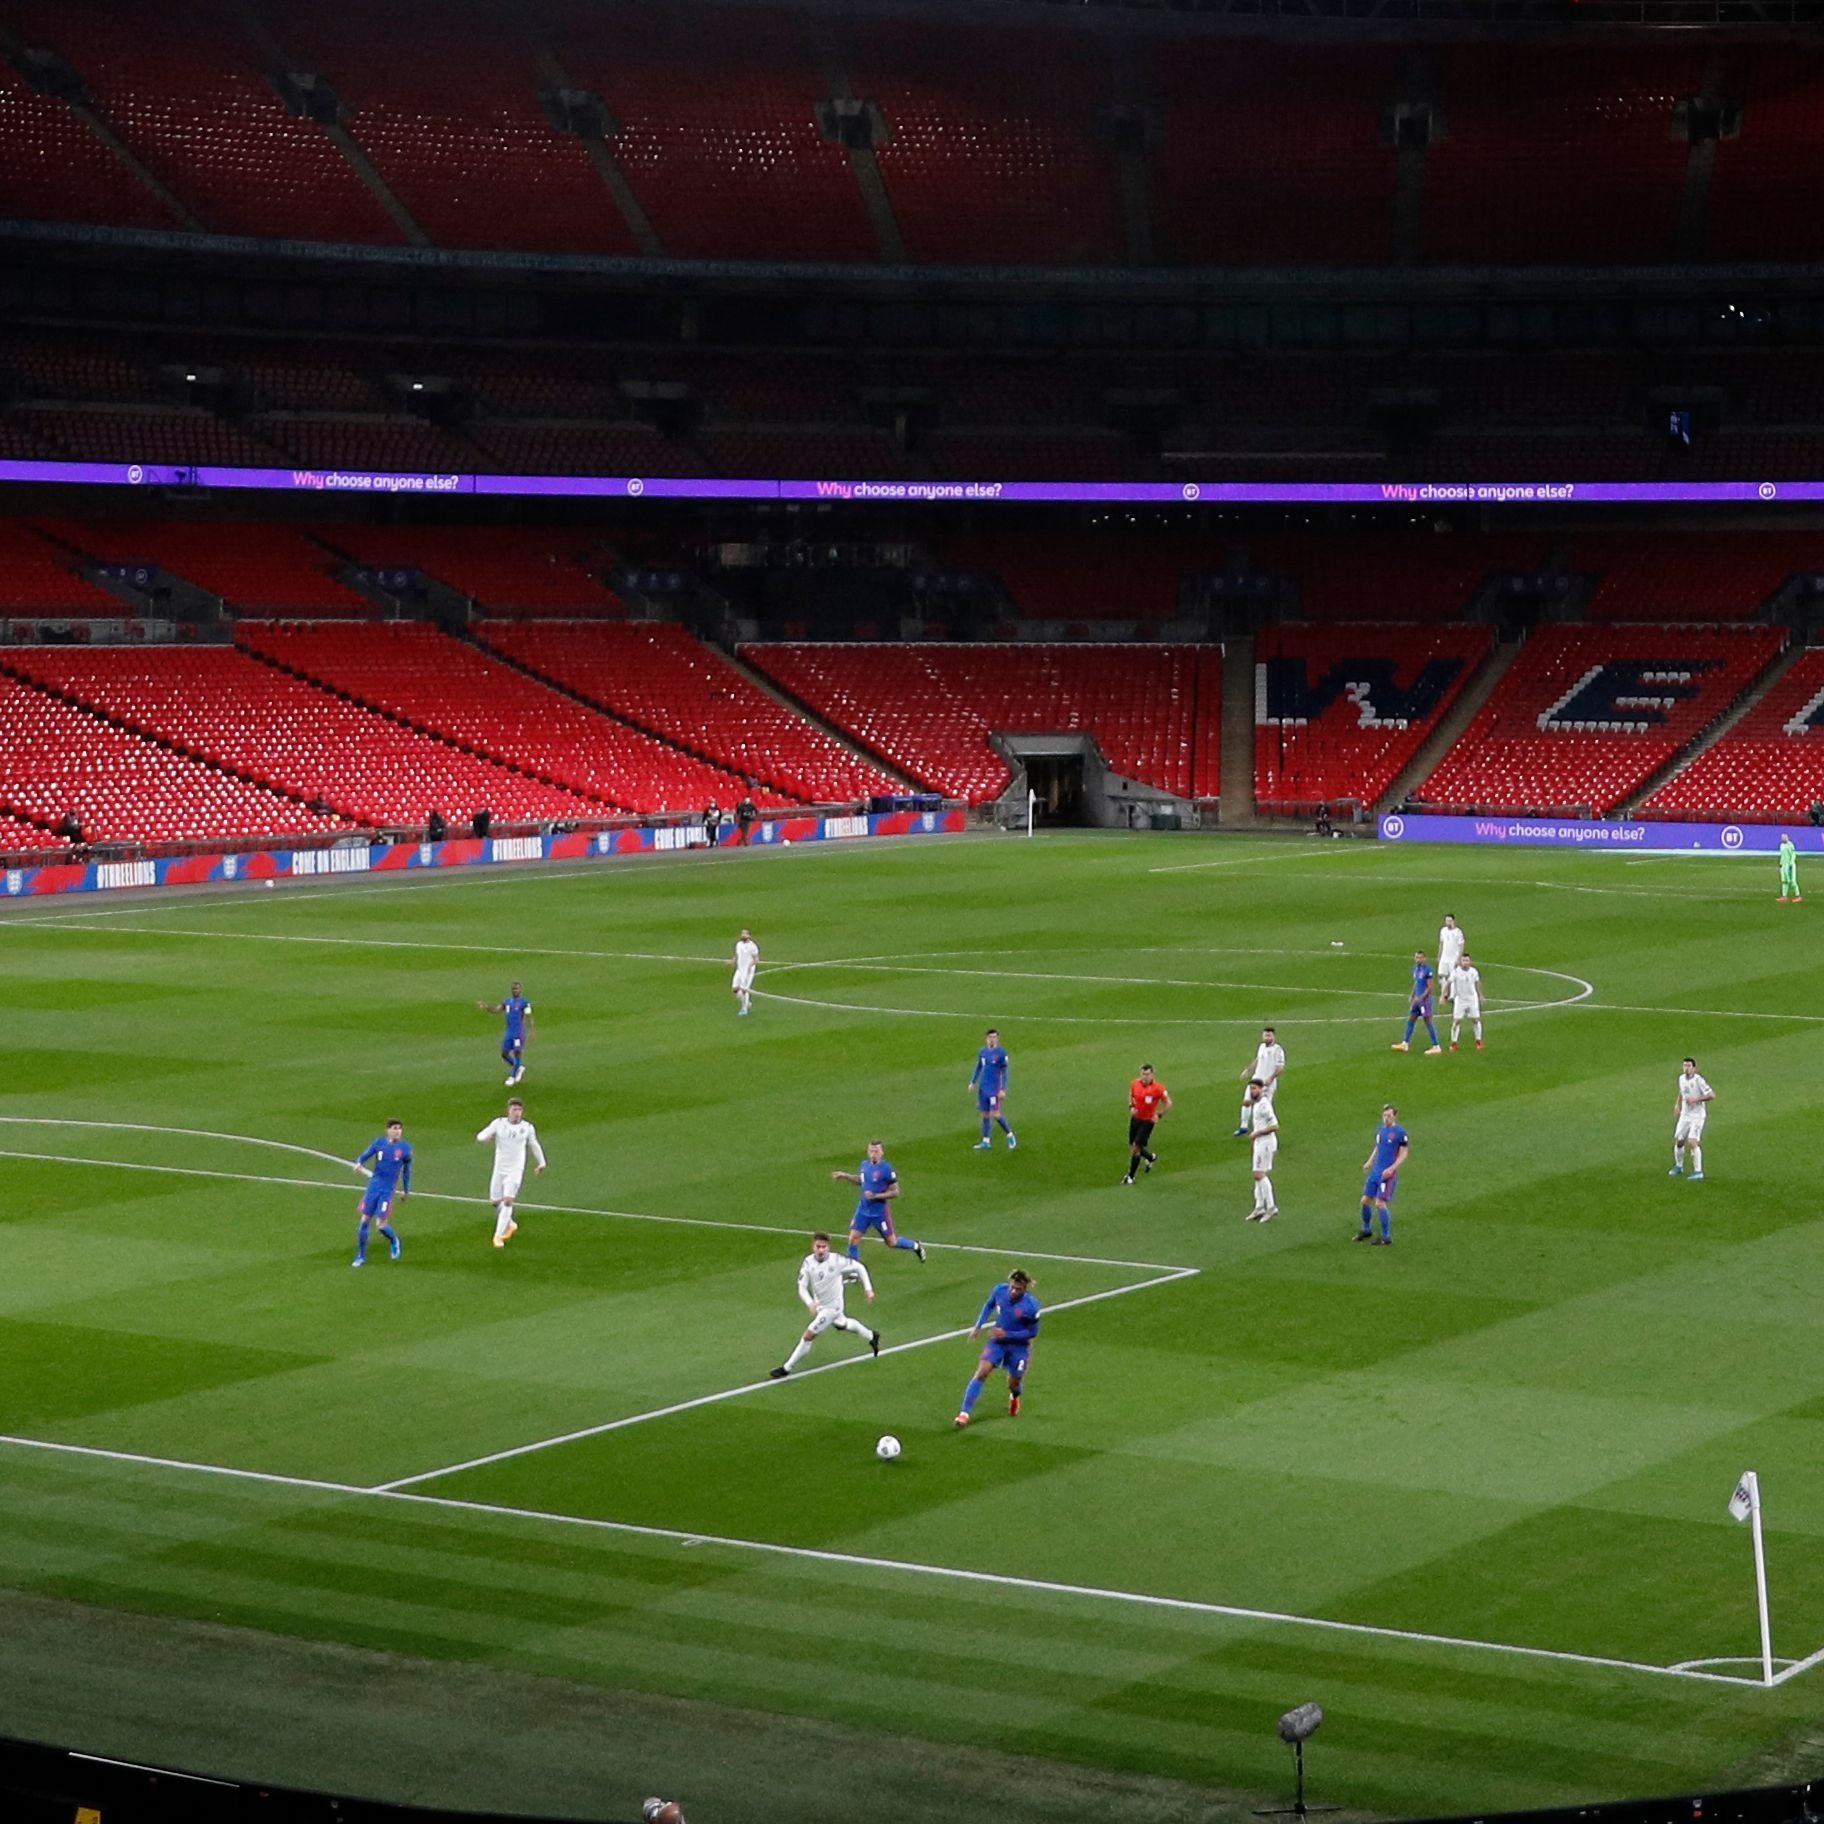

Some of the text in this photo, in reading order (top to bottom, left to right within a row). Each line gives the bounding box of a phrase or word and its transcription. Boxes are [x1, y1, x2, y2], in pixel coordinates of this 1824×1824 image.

[293, 471, 458, 492] Why choose anyone else?
[817, 481, 1002, 498] Why choose anyone else?
[1381, 484, 1574, 501] Why choose anyone else?
[1475, 823, 1645, 842] Why choose anyone else?
